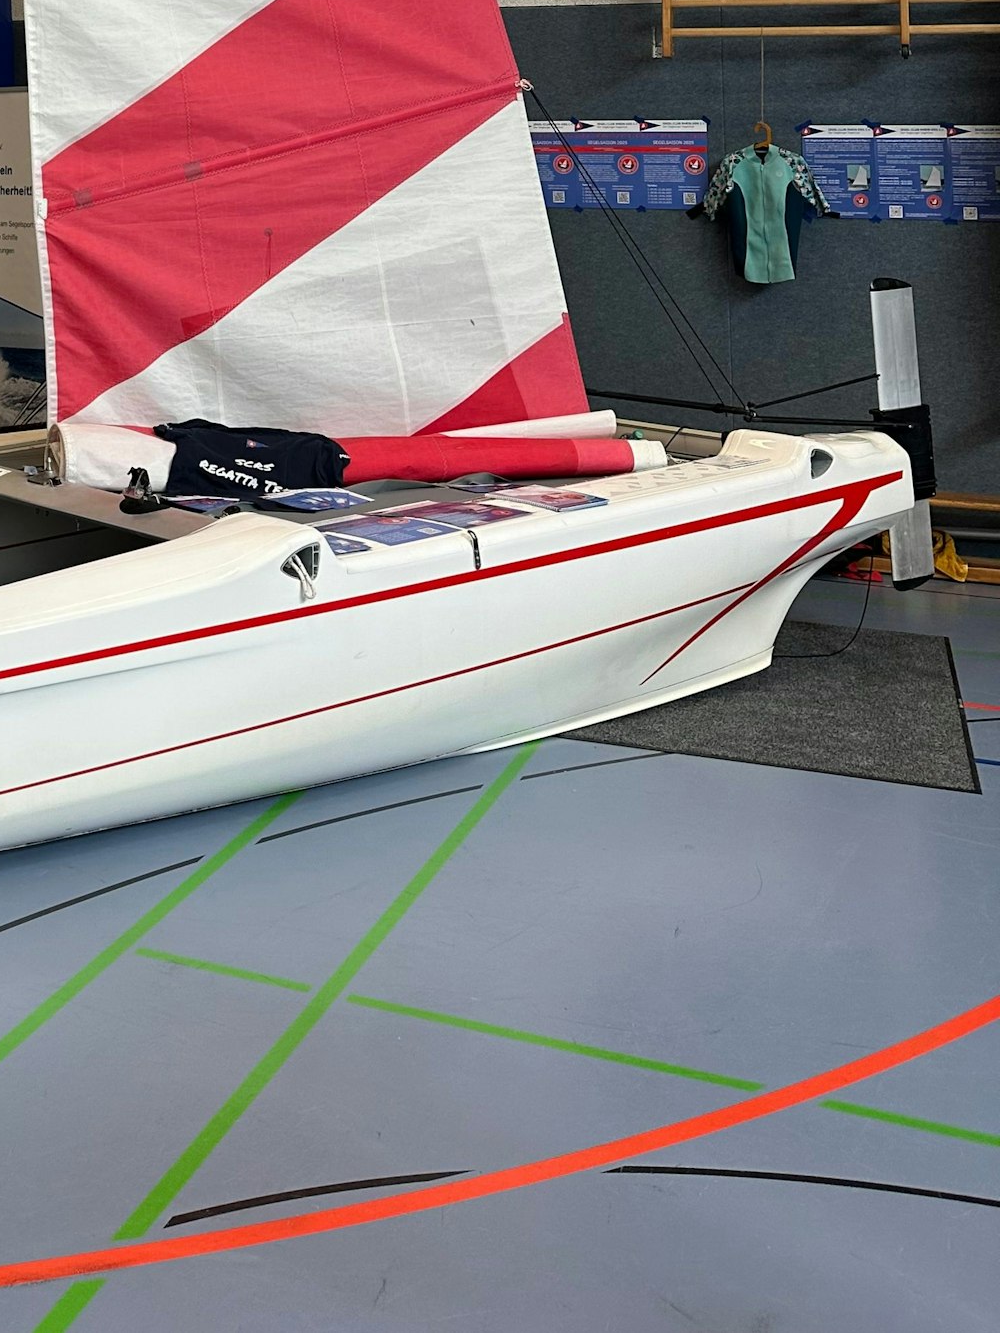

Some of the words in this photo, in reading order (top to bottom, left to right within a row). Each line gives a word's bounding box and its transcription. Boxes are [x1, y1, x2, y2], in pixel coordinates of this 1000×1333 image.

[199, 459, 259, 489] REGATTA
[264, 479, 289, 494] TE
[234, 458, 275, 472] SCRS
